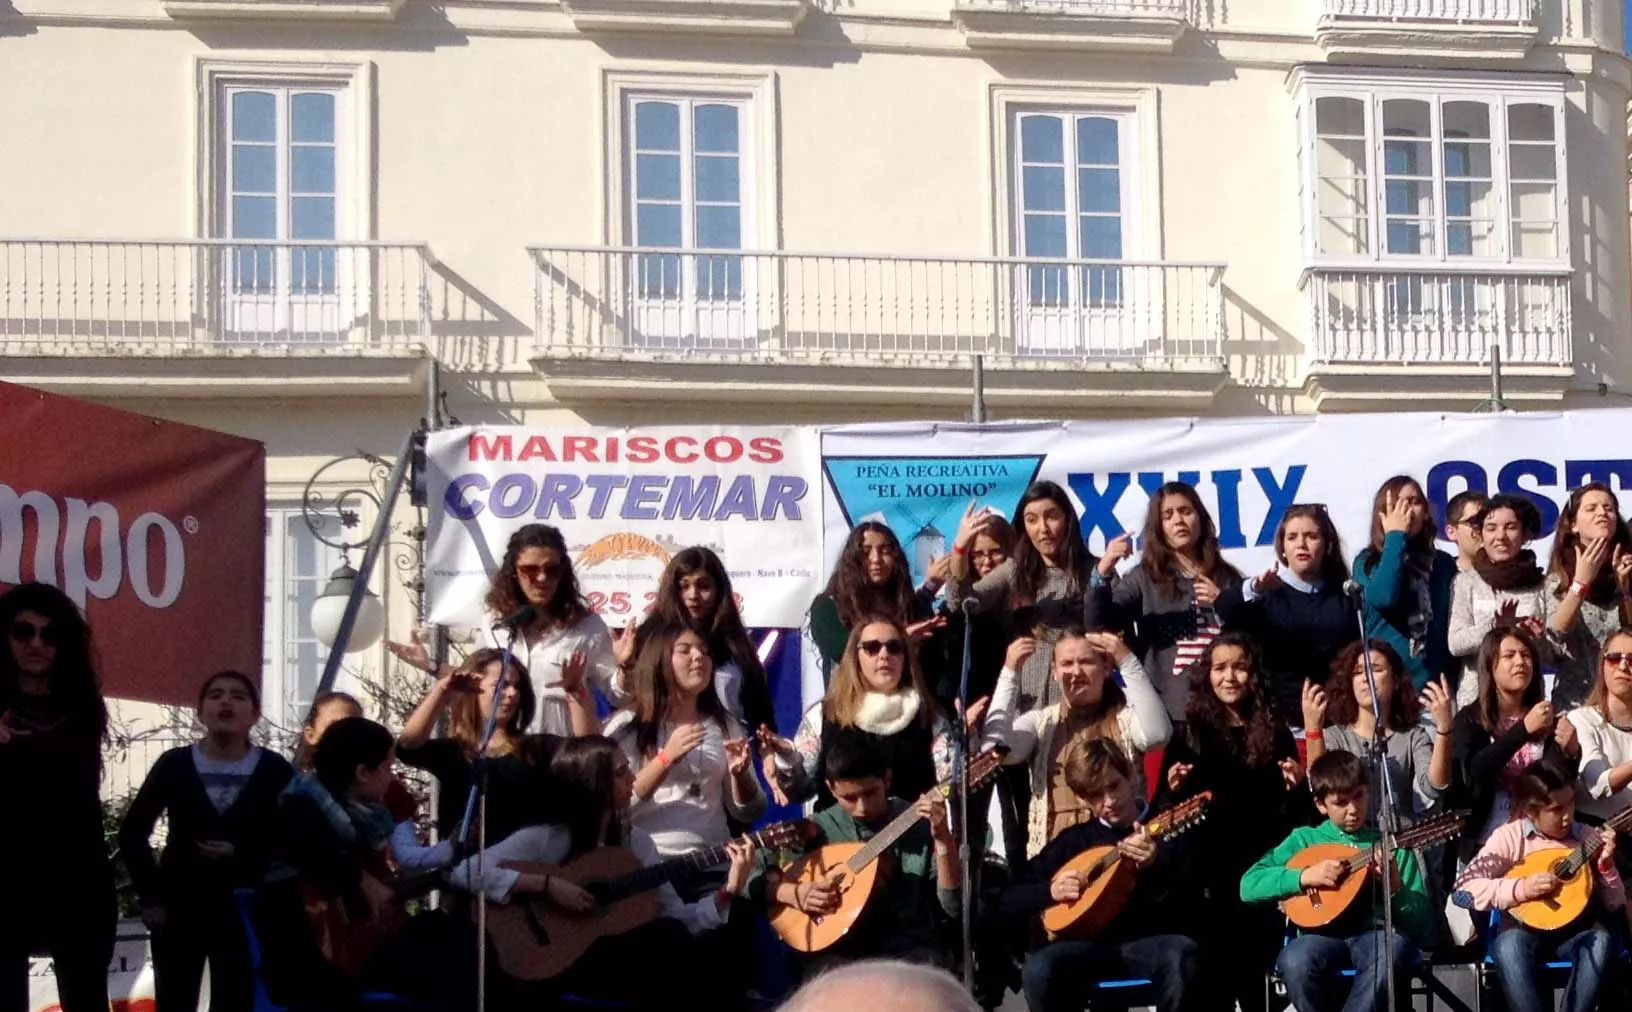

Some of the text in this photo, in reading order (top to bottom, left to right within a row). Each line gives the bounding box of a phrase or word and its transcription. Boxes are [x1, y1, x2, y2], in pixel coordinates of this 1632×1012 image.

[467, 434, 785, 464] MARISCOS
[856, 463, 1009, 478] PEÑA RECREATIVA
[443, 472, 809, 521] CORTEMAR
